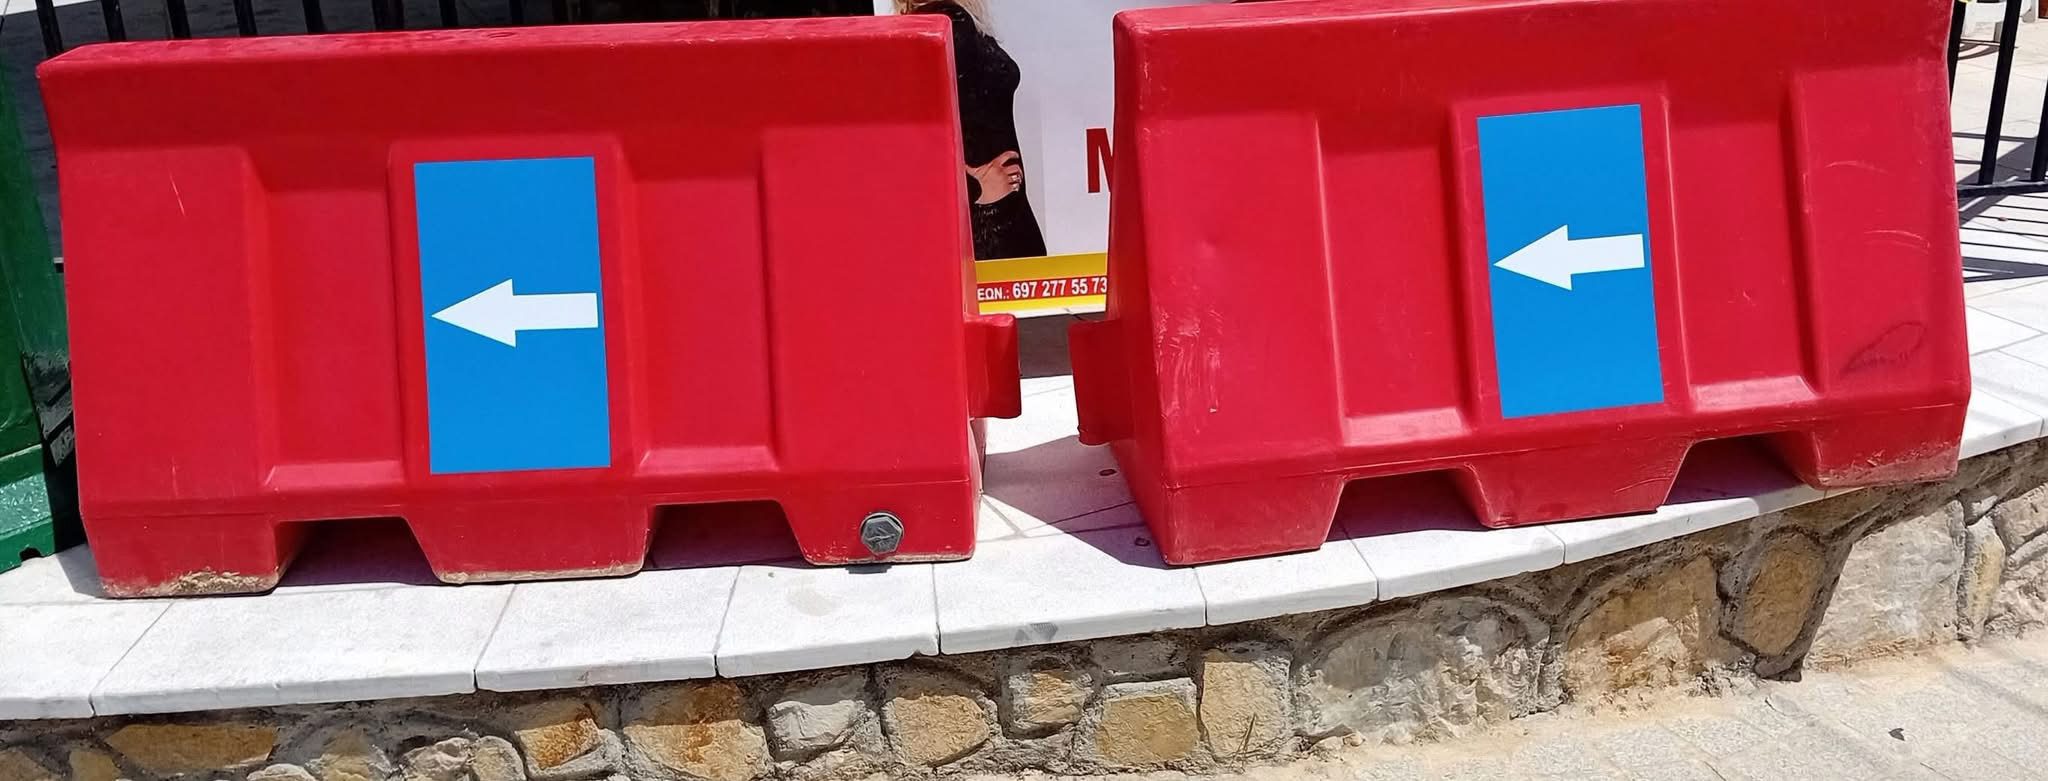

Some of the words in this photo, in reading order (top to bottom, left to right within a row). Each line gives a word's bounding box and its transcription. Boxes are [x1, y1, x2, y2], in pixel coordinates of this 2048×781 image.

[1012, 281, 1037, 299] 697
[1041, 279, 1067, 297] 277
[1071, 278, 1088, 295] 55
[1092, 276, 1108, 294] 73
